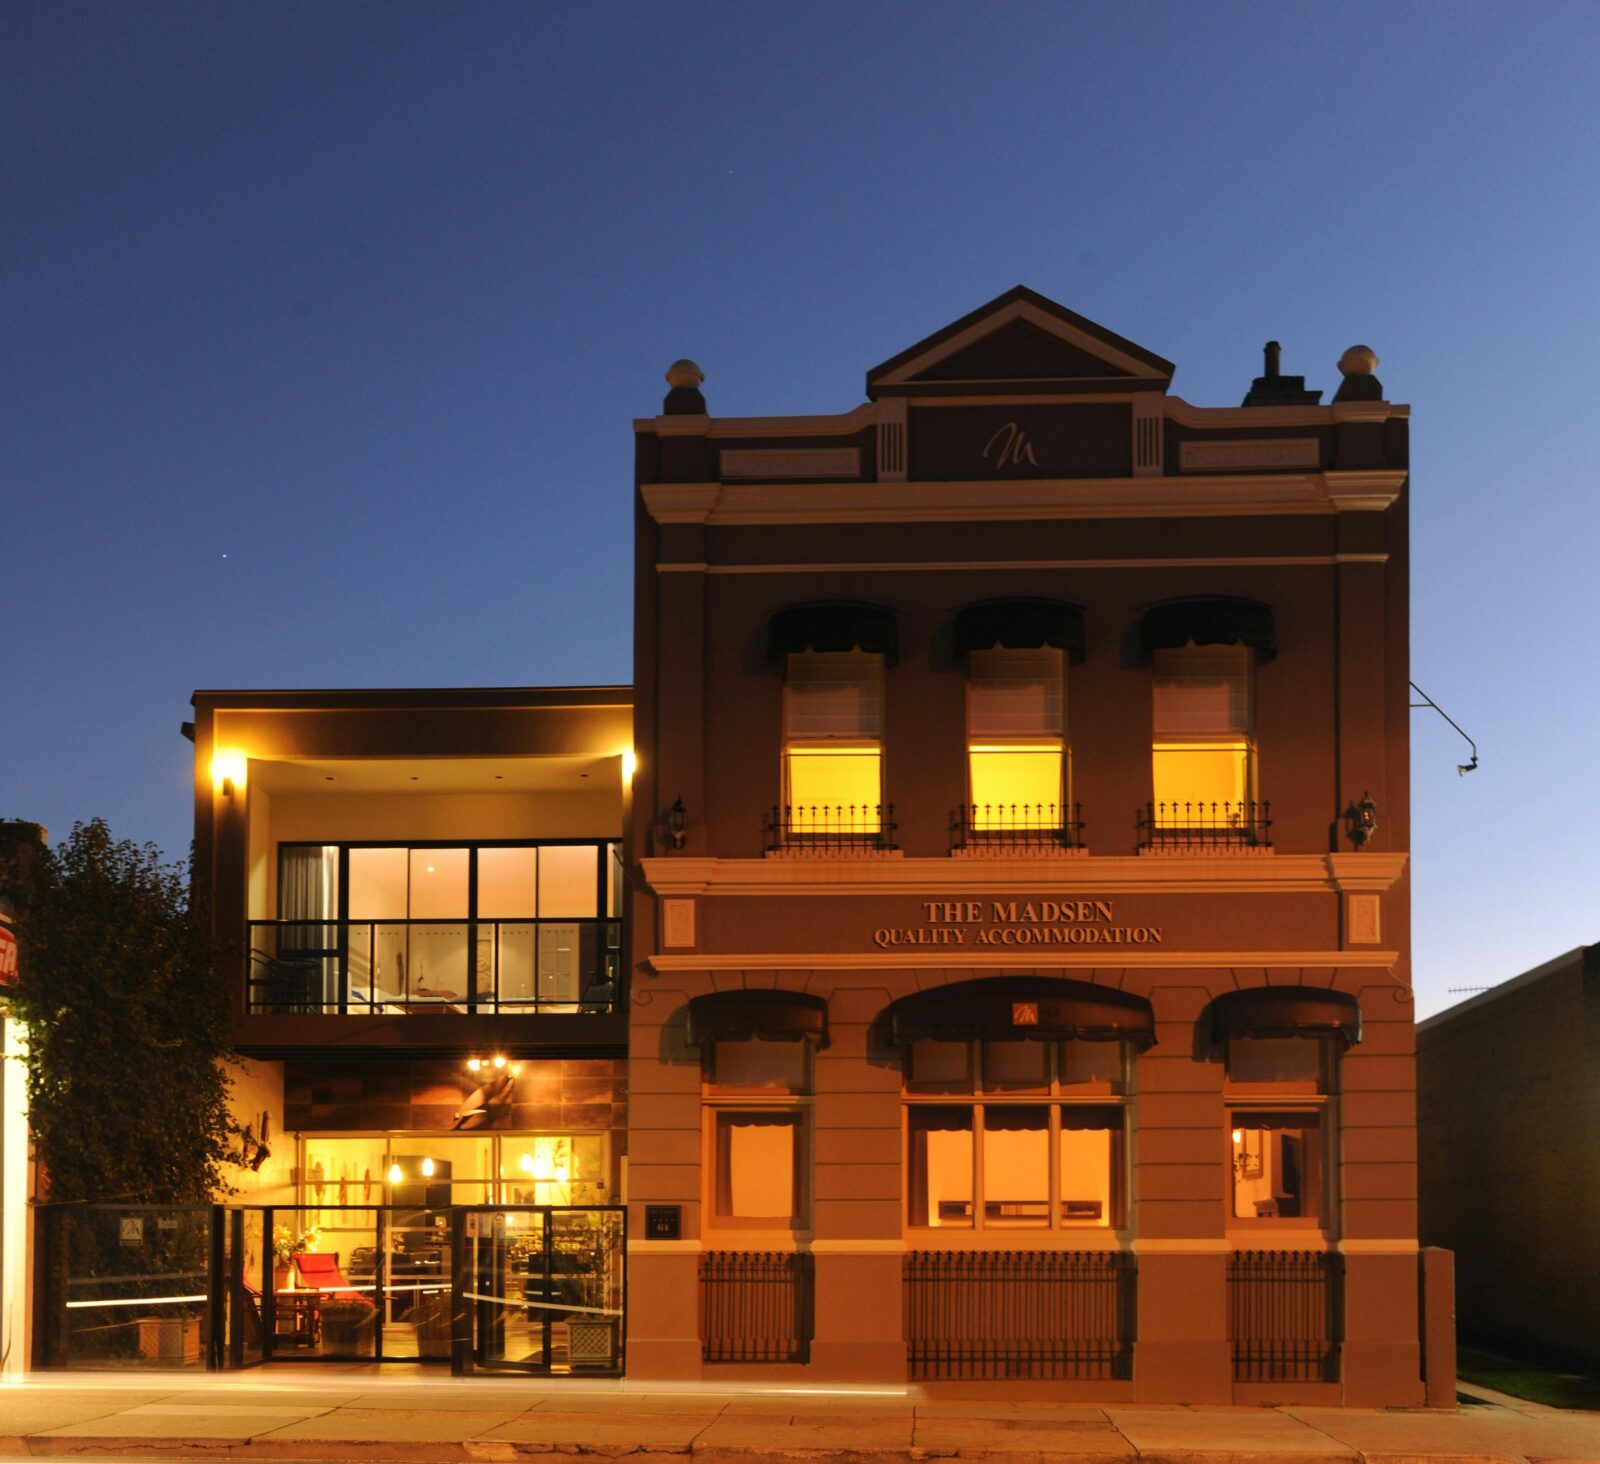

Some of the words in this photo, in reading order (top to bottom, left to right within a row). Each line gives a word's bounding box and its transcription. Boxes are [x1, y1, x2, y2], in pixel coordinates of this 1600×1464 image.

[923, 902, 982, 923] THE
[992, 901, 1113, 922] MADSEN
[874, 928, 967, 948] QUALITY
[975, 927, 1162, 944] ACCOMMODATION
